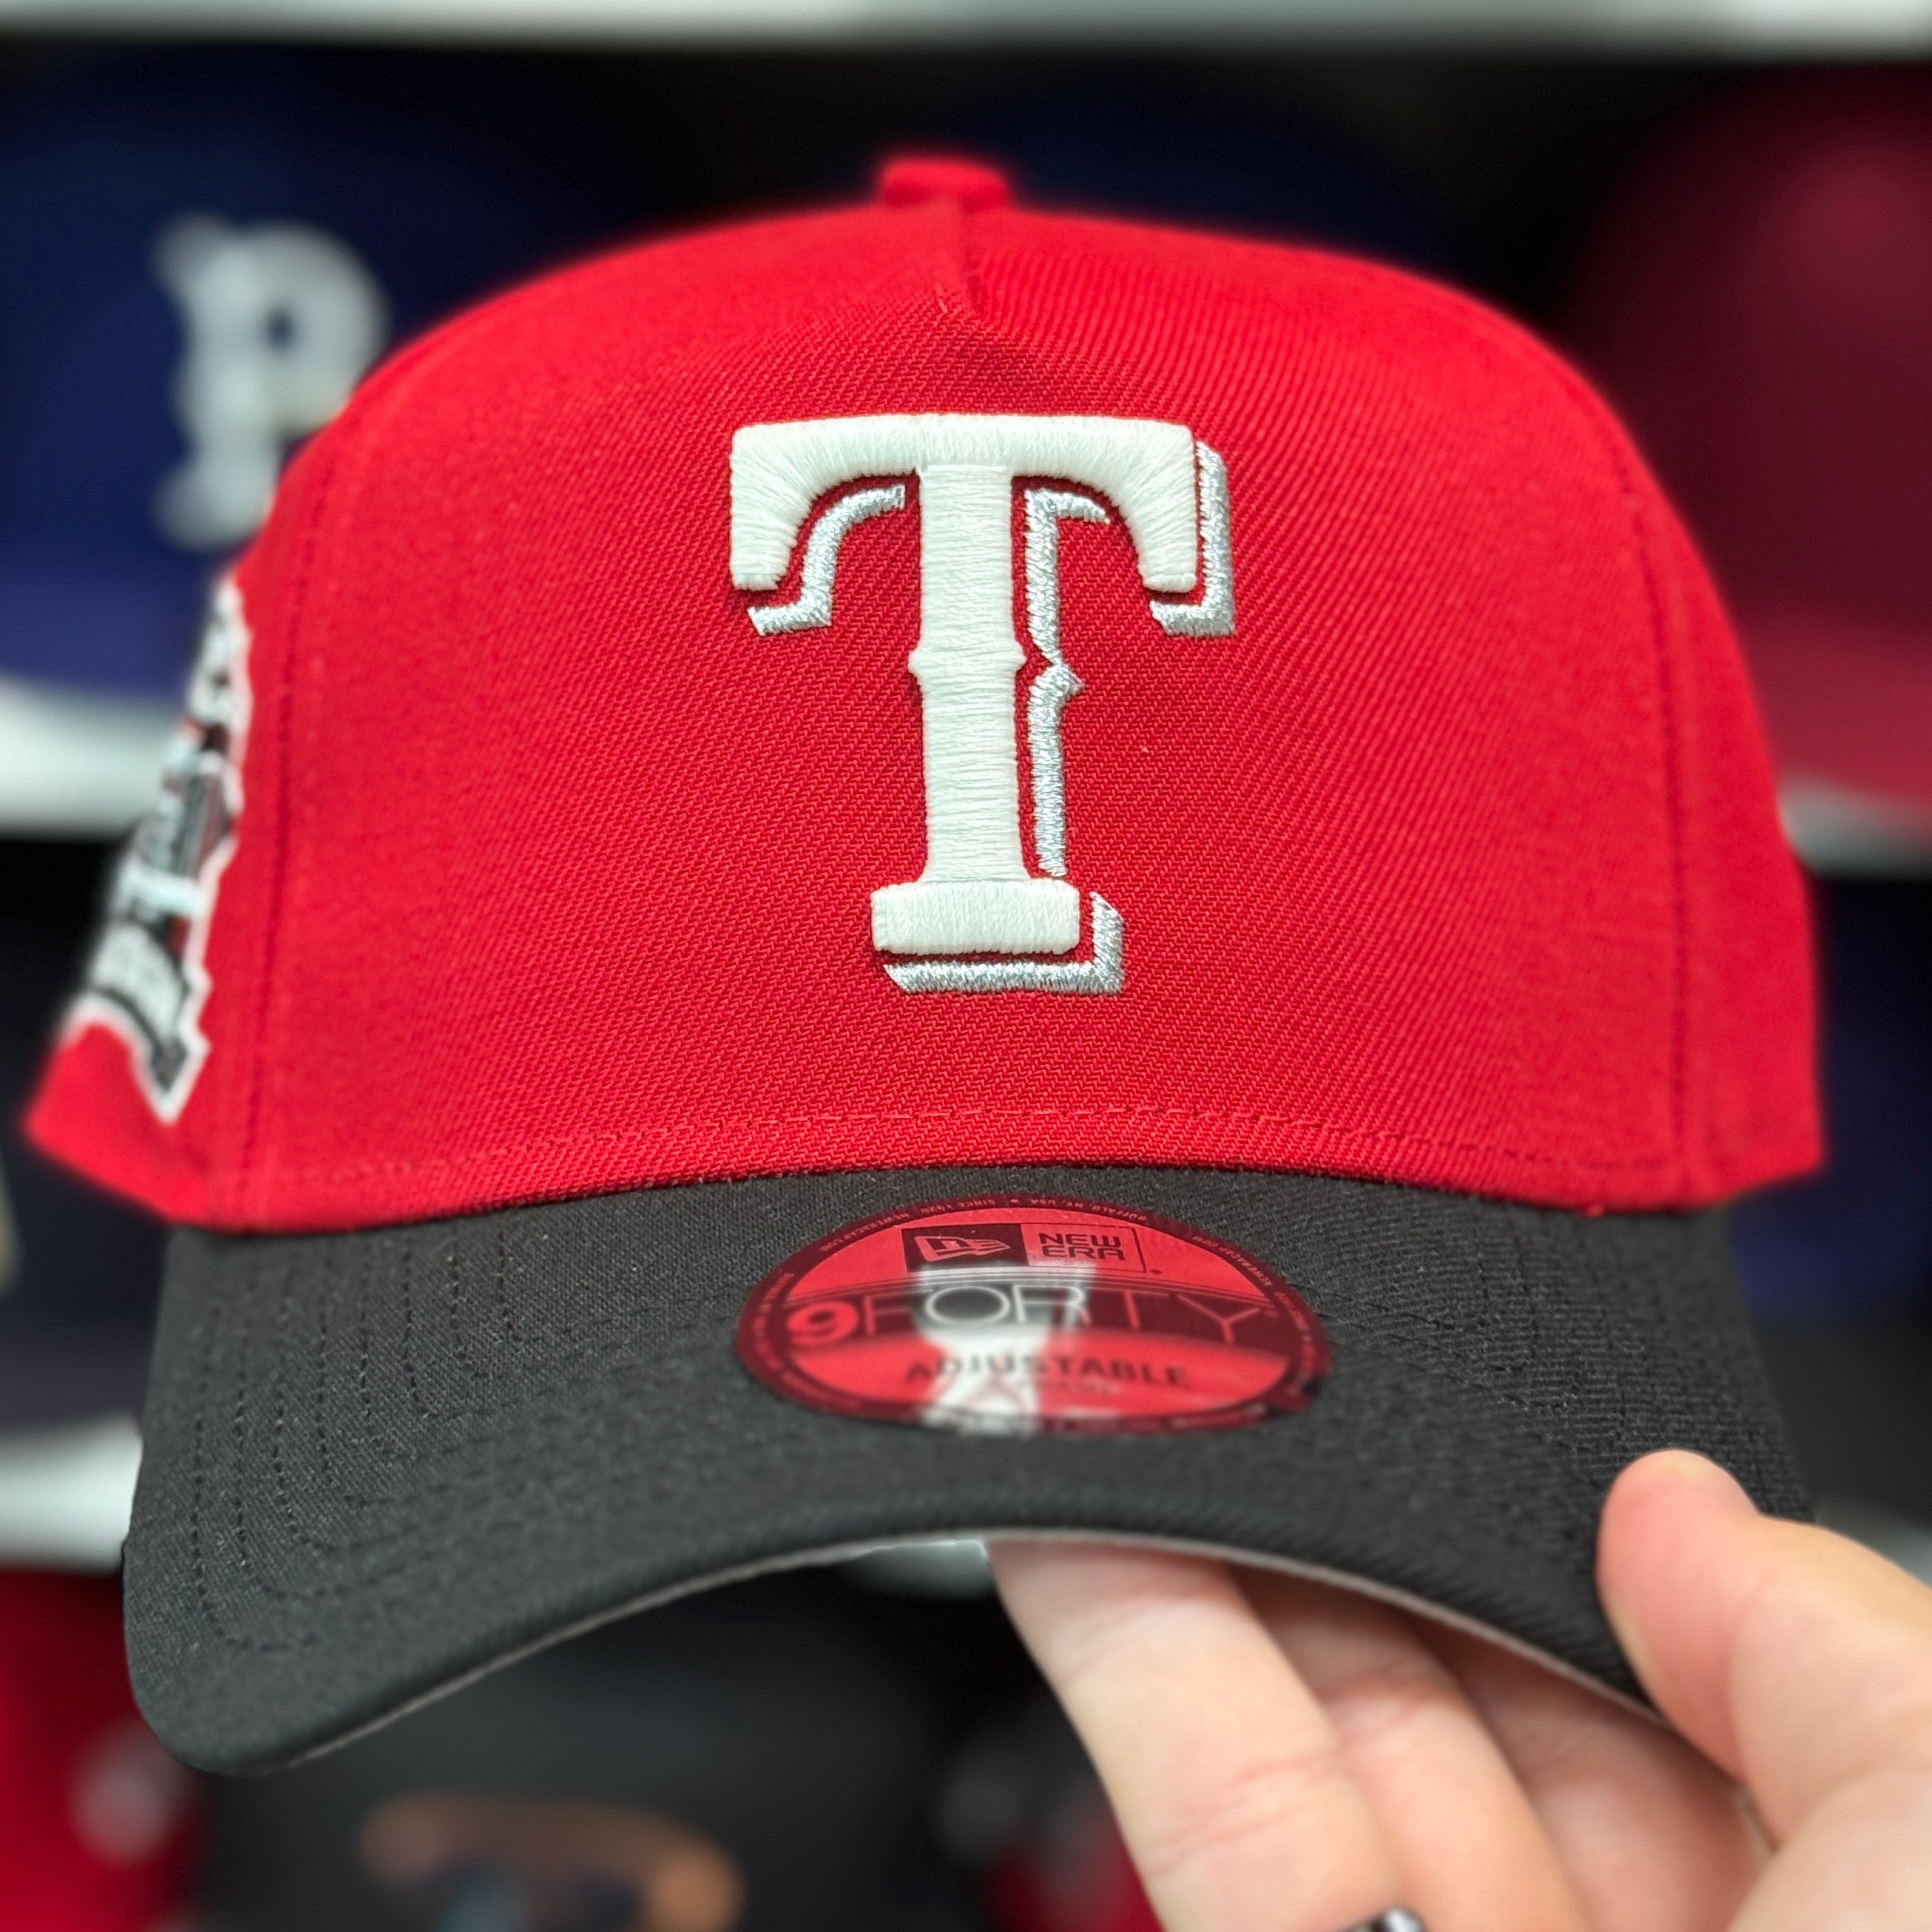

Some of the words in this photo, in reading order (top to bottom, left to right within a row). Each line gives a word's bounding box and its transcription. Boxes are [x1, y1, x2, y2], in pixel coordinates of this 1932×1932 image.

[729, 412, 1235, 994] T
[1038, 1232, 1122, 1247] NEW
[1040, 1245, 1125, 1261] ERA
[785, 1284, 1262, 1349] 9FORTY
[905, 1353, 1188, 1386] ADJUSTABLE
